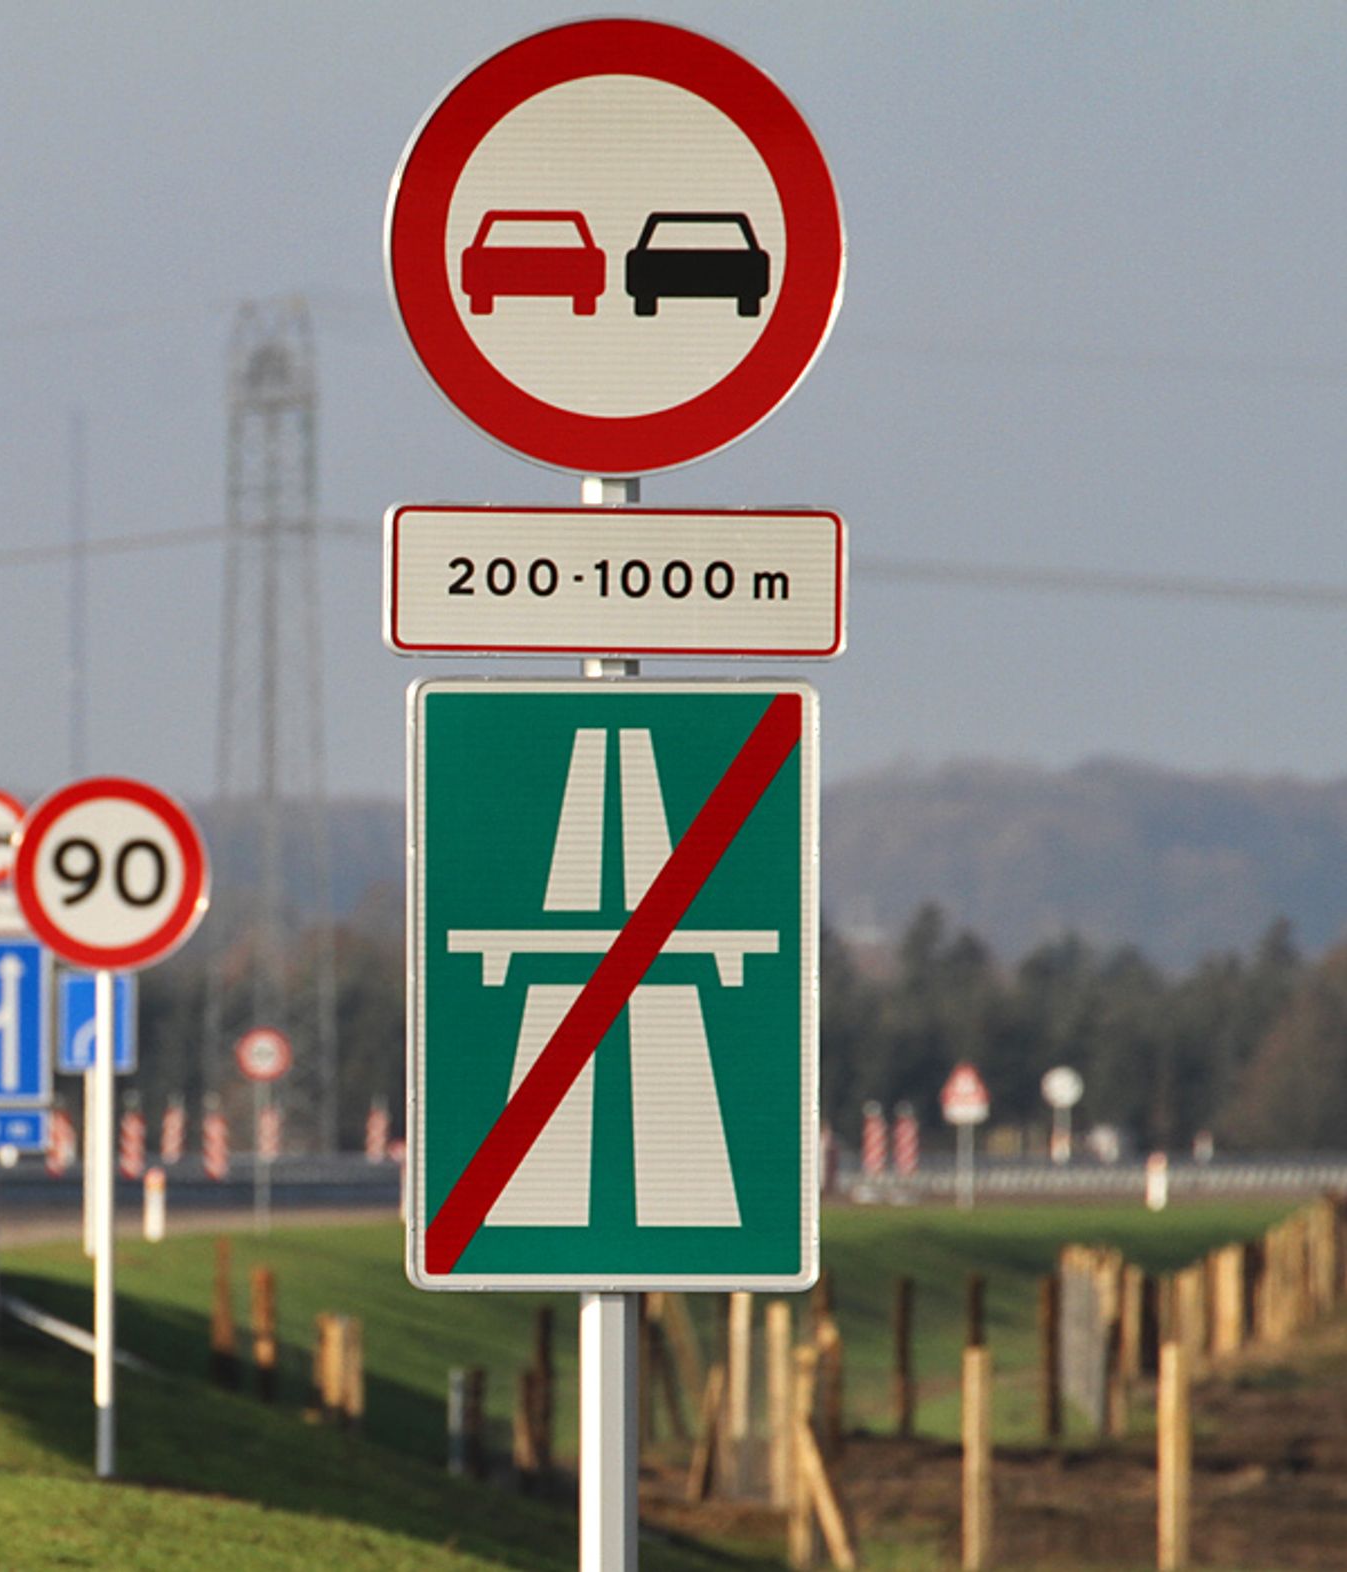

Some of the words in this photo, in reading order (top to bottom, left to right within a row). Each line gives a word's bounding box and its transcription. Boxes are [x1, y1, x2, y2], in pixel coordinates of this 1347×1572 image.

[448, 557, 735, 600] 200-1000
[753, 571, 789, 600] m
[52, 837, 167, 908] 90
